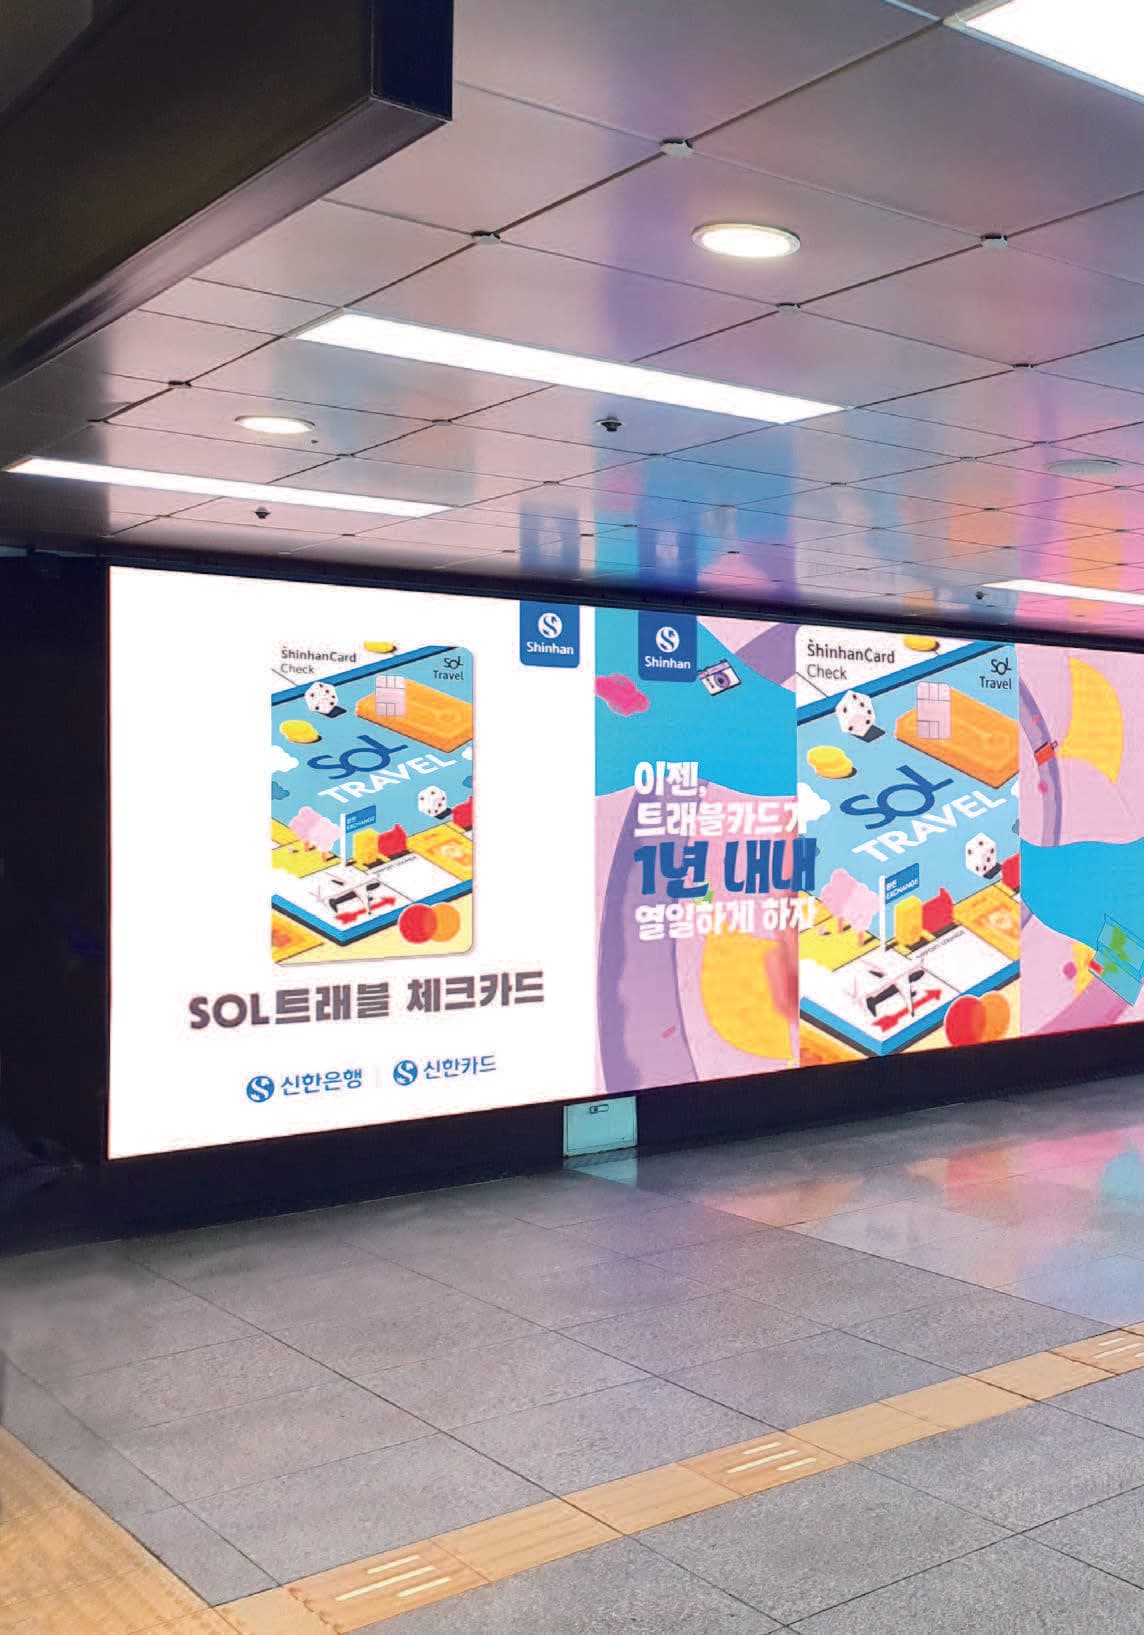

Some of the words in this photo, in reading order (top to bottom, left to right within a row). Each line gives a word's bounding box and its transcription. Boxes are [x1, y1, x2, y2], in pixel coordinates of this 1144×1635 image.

[281, 647, 358, 663] ShinhanCard
[526, 640, 575, 656] Shinhan
[806, 642, 895, 665] ShinhanCard
[280, 663, 315, 674] Check
[644, 655, 691, 670] Shinhan
[806, 663, 848, 681] Check
[433, 670, 465, 681] Travel
[979, 675, 1013, 692] Travel
[317, 752, 458, 803] TRAVEL
[634, 800, 807, 838] 트래블카드가
[852, 788, 1007, 865] TRAVEL
[633, 840, 709, 899] 1년
[724, 837, 817, 894] 내내
[634, 899, 755, 941] 열일하게
[762, 896, 817, 931] 하자
[188, 981, 391, 1030] SOL트래블
[406, 970, 545, 1013] 체크카드
[280, 1067, 364, 1096] 신한은행
[423, 1054, 497, 1079] 신한카드
